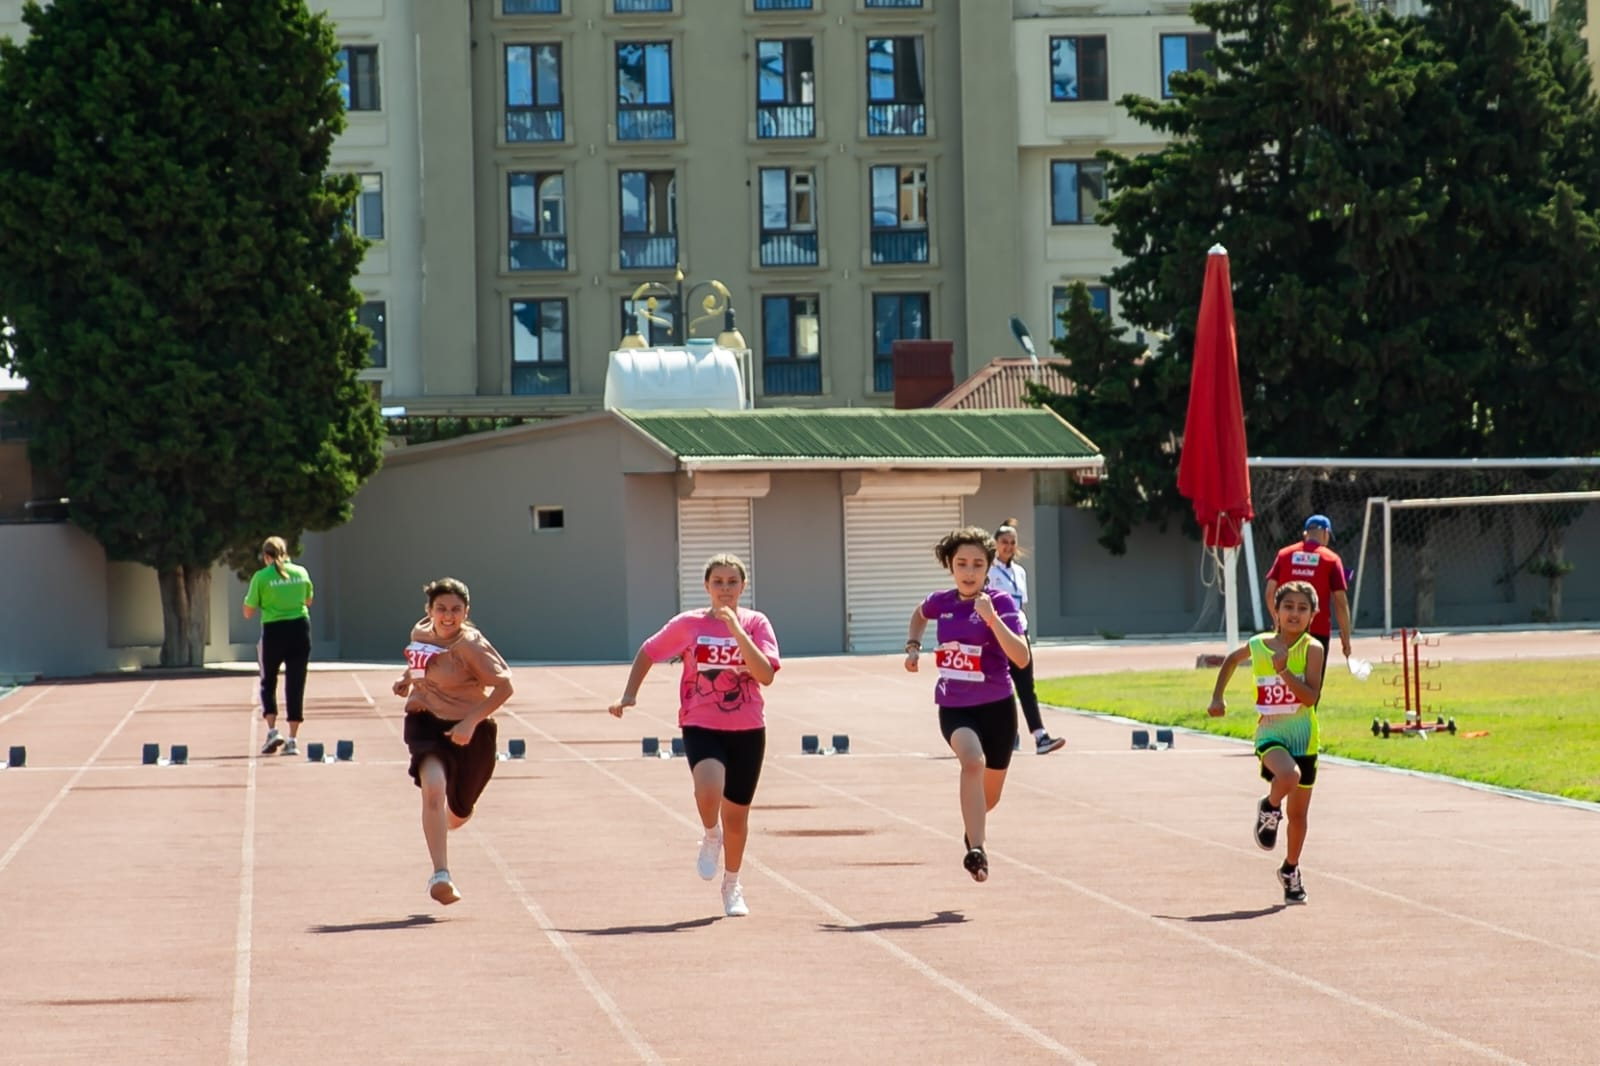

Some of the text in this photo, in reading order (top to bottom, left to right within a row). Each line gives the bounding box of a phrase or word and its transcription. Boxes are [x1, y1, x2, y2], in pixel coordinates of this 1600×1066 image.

[408, 650, 433, 669] 377
[707, 645, 743, 665] 354
[941, 650, 974, 670] 364
[1264, 685, 1296, 704] 395
